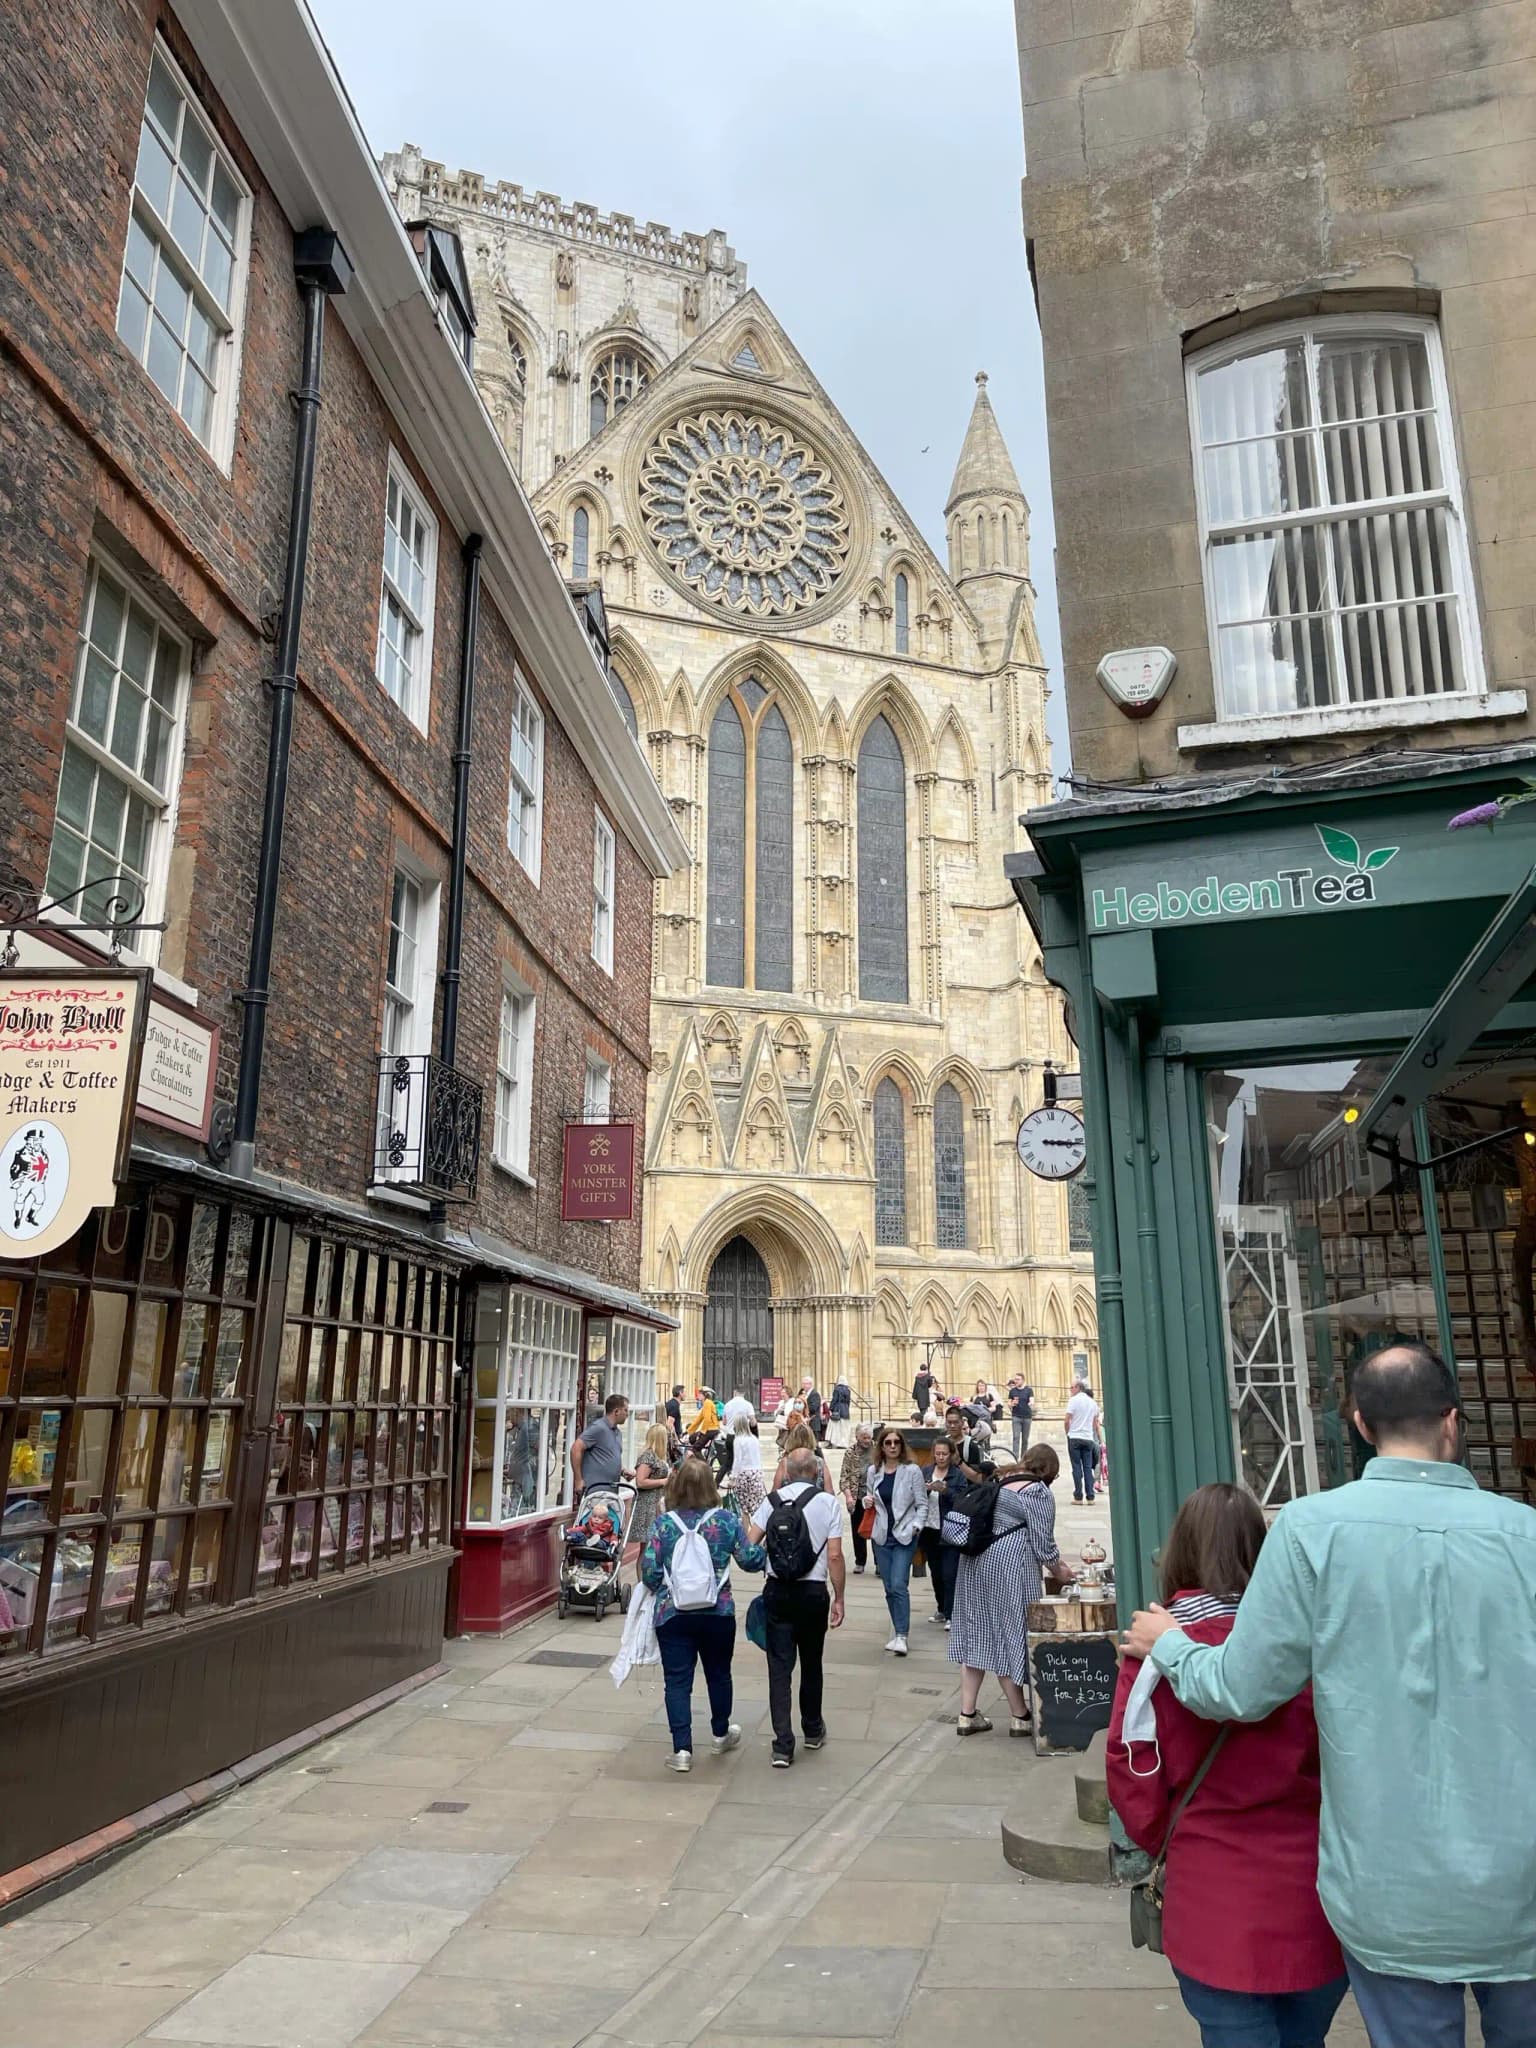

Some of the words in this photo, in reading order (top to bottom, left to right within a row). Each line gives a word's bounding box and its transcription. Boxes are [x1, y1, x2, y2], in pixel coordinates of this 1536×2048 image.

[1092, 868, 1376, 928] HebdenTea
[60, 1005, 126, 1037] Bull
[147, 1026, 172, 1049] Fudge
[173, 1038, 180, 1053] &
[25, 1059, 43, 1069] Est
[47, 1059, 70, 1069] 1911
[155, 1050, 184, 1074] Makers
[185, 1063, 192, 1078] &
[39, 1071, 54, 1089] &
[62, 1071, 118, 1089] Toffee
[150, 1067, 193, 1097] Chocolatiers
[6, 1095, 77, 1114] Makers
[583, 1163, 616, 1174] YORK
[571, 1178, 627, 1189] MINSTER
[580, 1192, 616, 1203] GIFTS
[1045, 1653, 1067, 1666] Pick
[1071, 1657, 1088, 1670] any
